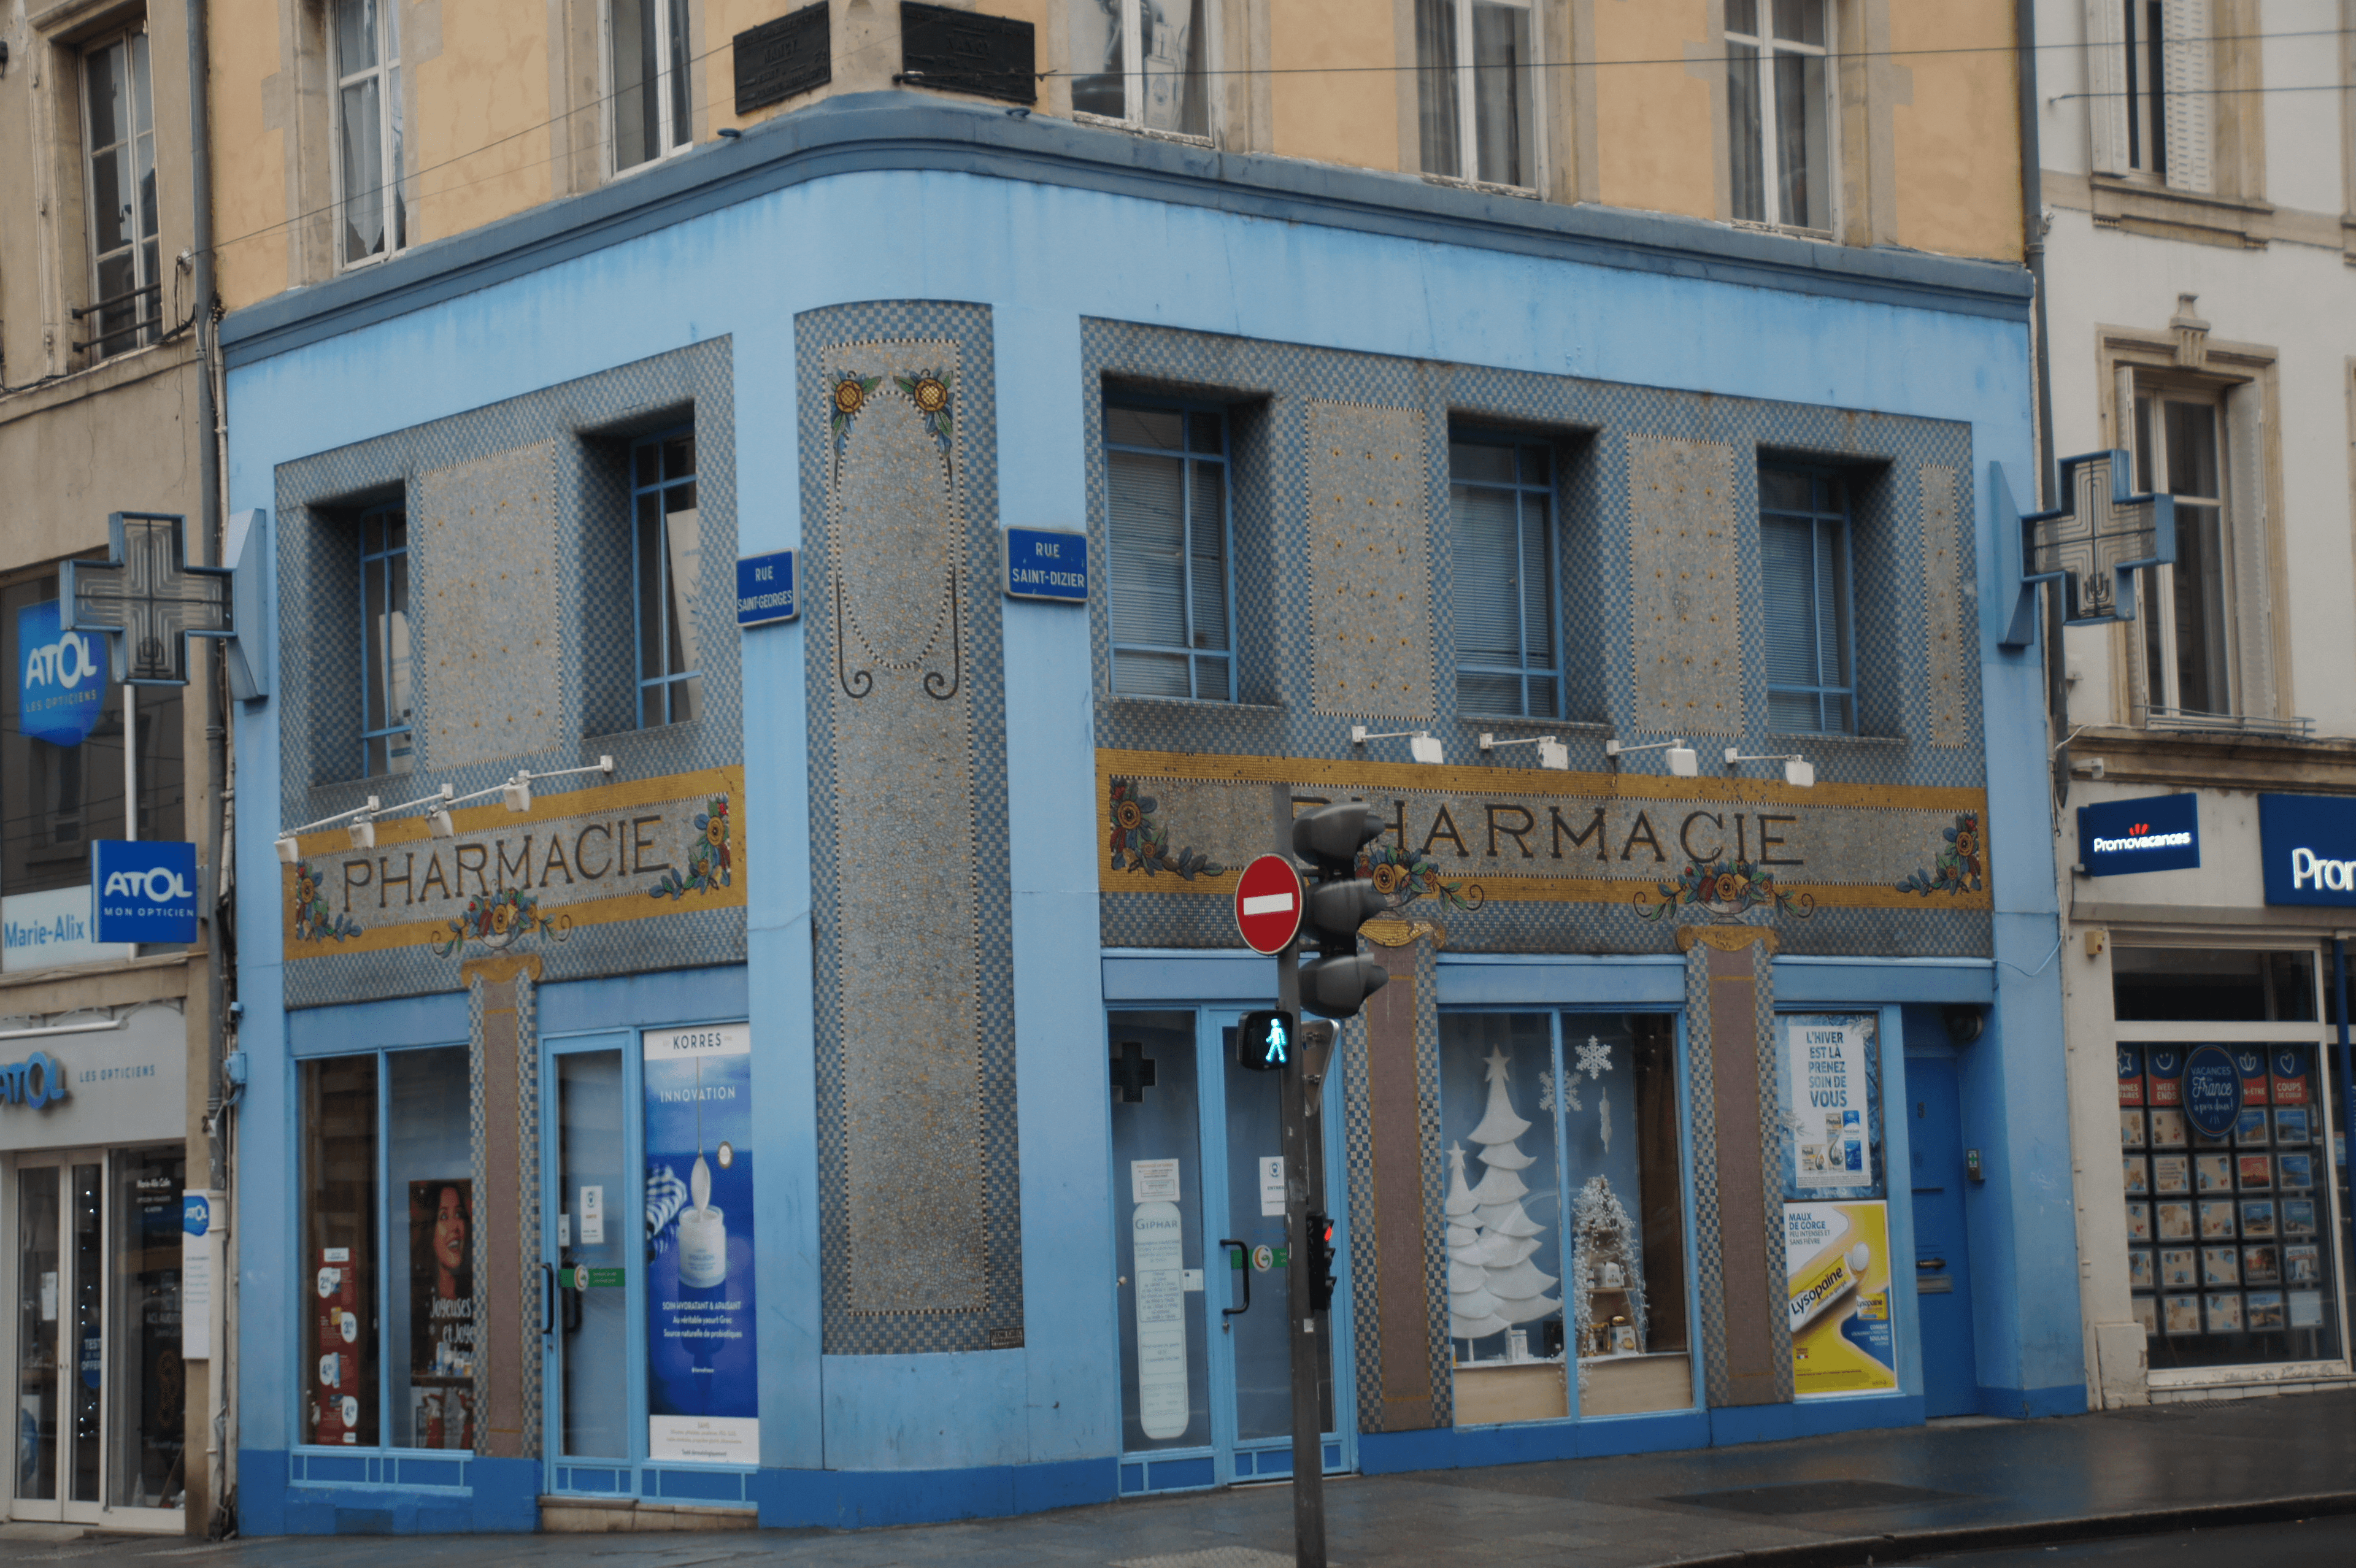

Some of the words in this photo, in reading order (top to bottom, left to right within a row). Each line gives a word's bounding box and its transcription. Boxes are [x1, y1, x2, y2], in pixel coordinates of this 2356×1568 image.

[1036, 542, 1060, 558] RUE
[755, 565, 773, 582] RUE
[1012, 567, 1085, 588] SAINT-DIZIER
[737, 590, 793, 612] SAINT-GEORGES
[26, 631, 97, 689] ATOL
[26, 699, 42, 713] LES
[45, 690, 97, 709] OPTICIENS
[1291, 796, 1804, 865] HARMACIE
[2093, 832, 2190, 853] Promovacances
[344, 814, 670, 912] PHARMACIE
[104, 867, 193, 902] ATOL
[104, 907, 133, 917] MON
[138, 907, 194, 917] OPTICIEN
[4, 914, 85, 948] Marie-Alix
[673, 1032, 721, 1050] KORRES
[1806, 1031, 1844, 1043] L'HIVER
[1809, 1047, 1827, 1059] EST
[1829, 1043, 1841, 1059] LÀ
[80, 1070, 96, 1083] LES
[101, 1065, 155, 1080] OPTICIENS
[1809, 1061, 1846, 1073] PRENEZ
[1809, 1076, 1831, 1088] SOIN
[1834, 1075, 1847, 1088] DE
[2192, 1076, 2233, 1097] France
[2277, 1083, 2301, 1091] COUPS
[660, 1086, 736, 1102] INNOVATION
[1809, 1090, 1847, 1107] VOUS
[2157, 1091, 2177, 1100] ENDS
[185, 1205, 207, 1221] ATOL
[1801, 1221, 1826, 1229] GORGE
[430, 1296, 472, 1318] Joyeuses
[663, 1301, 676, 1310] SOIN
[676, 1301, 709, 1310] HYDRATANT
[709, 1301, 715, 1310] &
[715, 1301, 742, 1310] APAISANT
[442, 1323, 453, 1342] et
[664, 1328, 680, 1337] Source
[681, 1328, 703, 1337] naturelle
[710, 1329, 742, 1339] probiotiques
